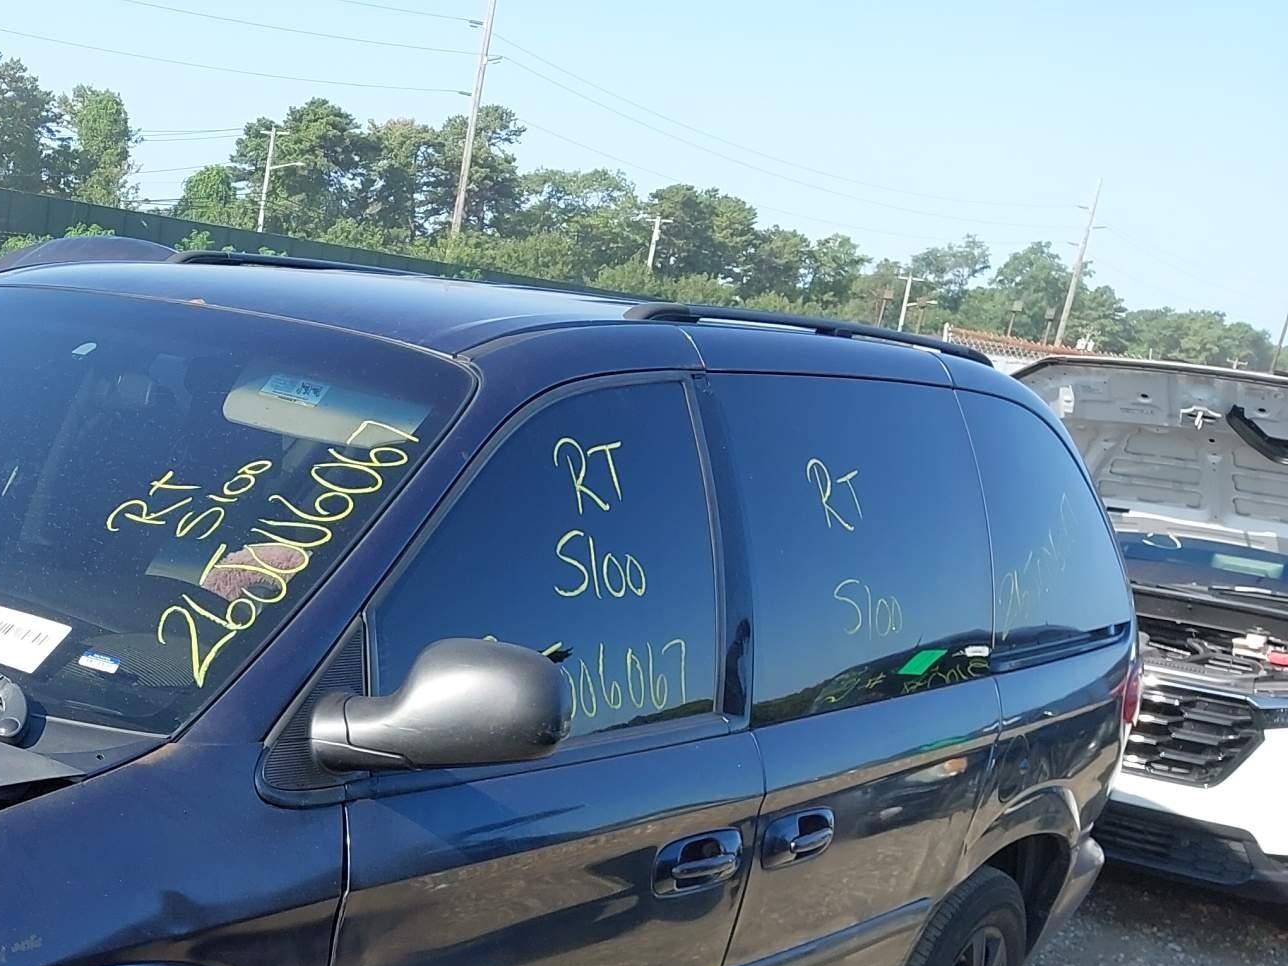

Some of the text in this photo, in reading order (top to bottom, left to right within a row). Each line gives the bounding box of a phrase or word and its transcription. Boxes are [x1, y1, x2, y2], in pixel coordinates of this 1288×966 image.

[175, 460, 273, 540] S100
[553, 437, 622, 515] RT
[806, 458, 862, 531] RT
[554, 529, 647, 600] S100
[833, 578, 903, 640] S100
